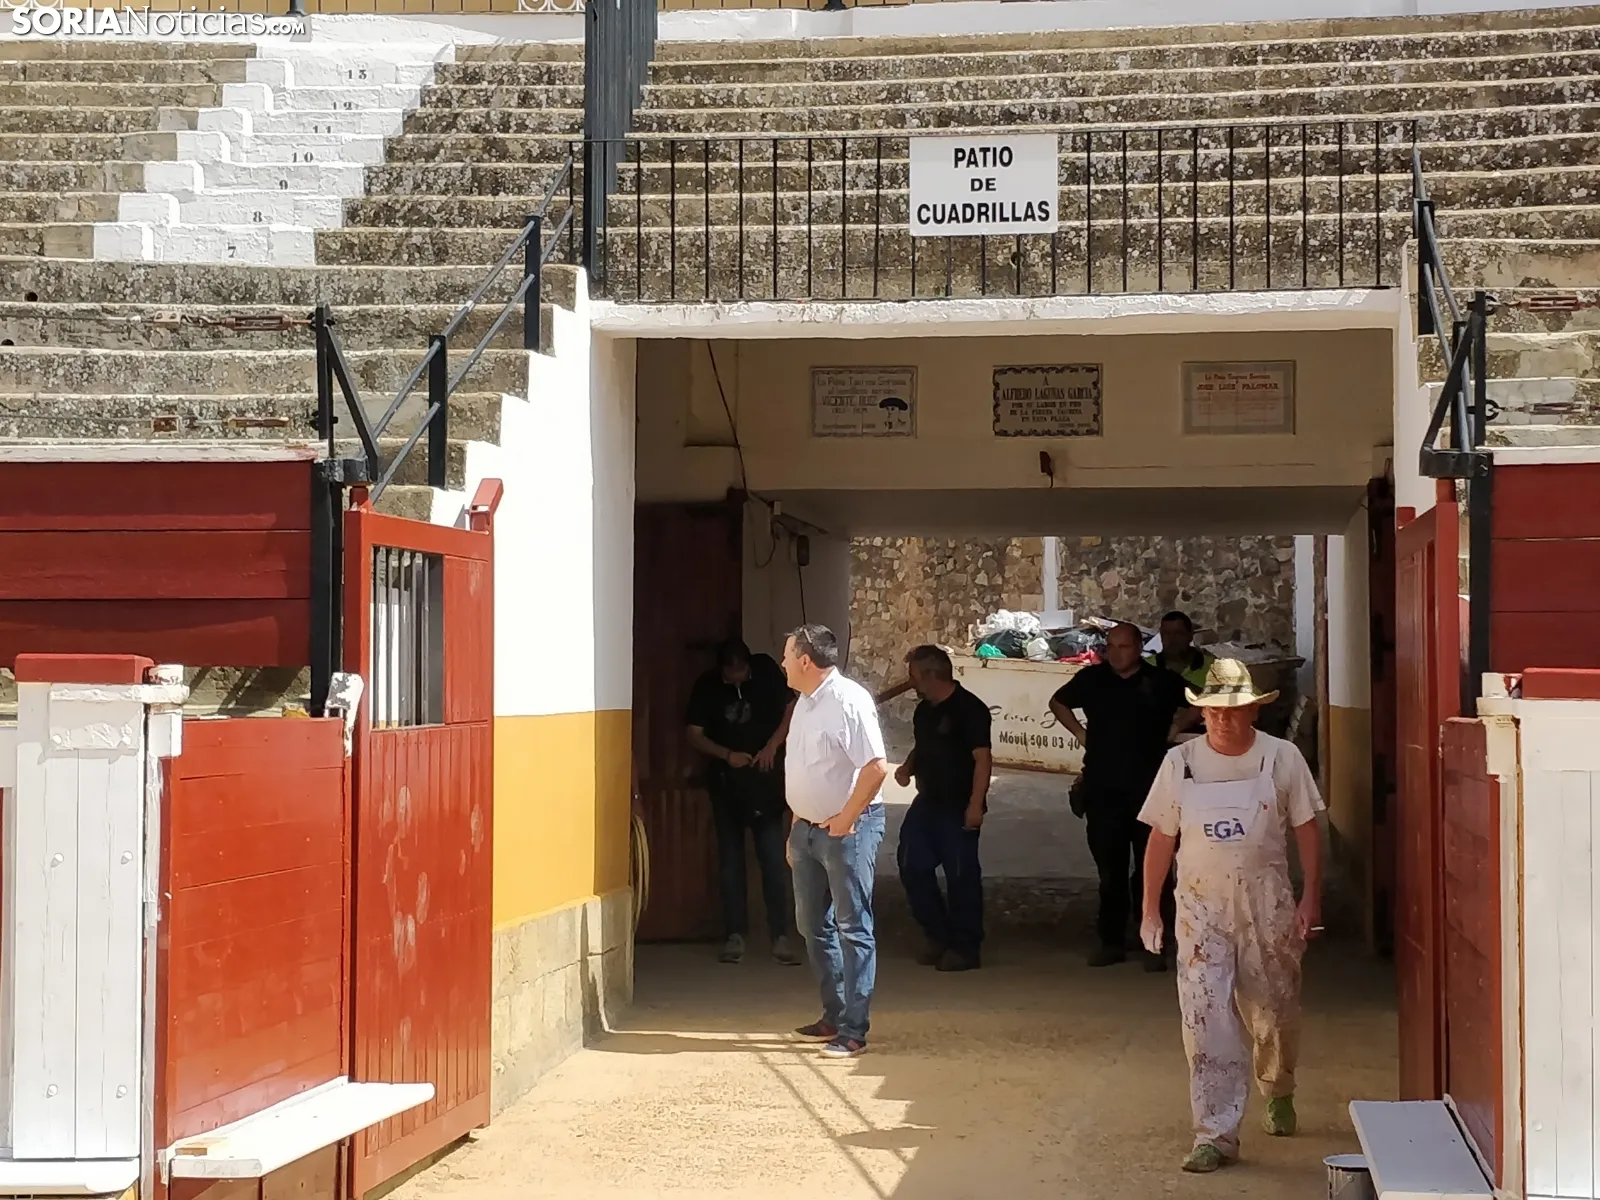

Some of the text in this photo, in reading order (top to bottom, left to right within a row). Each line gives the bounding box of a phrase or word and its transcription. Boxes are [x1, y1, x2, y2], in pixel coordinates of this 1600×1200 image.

[292, 151, 314, 163] 10
[953, 146, 1013, 168] PATIO
[279, 179, 289, 190] 9
[970, 177, 997, 192] DE
[252, 210, 263, 223] 8
[916, 200, 1050, 225] CUADRILLAS
[227, 245, 237, 258] 7
[1042, 376, 1049, 386] A
[1002, 387, 1032, 400] ALFREDO
[999, 731, 1028, 746] Móvil
